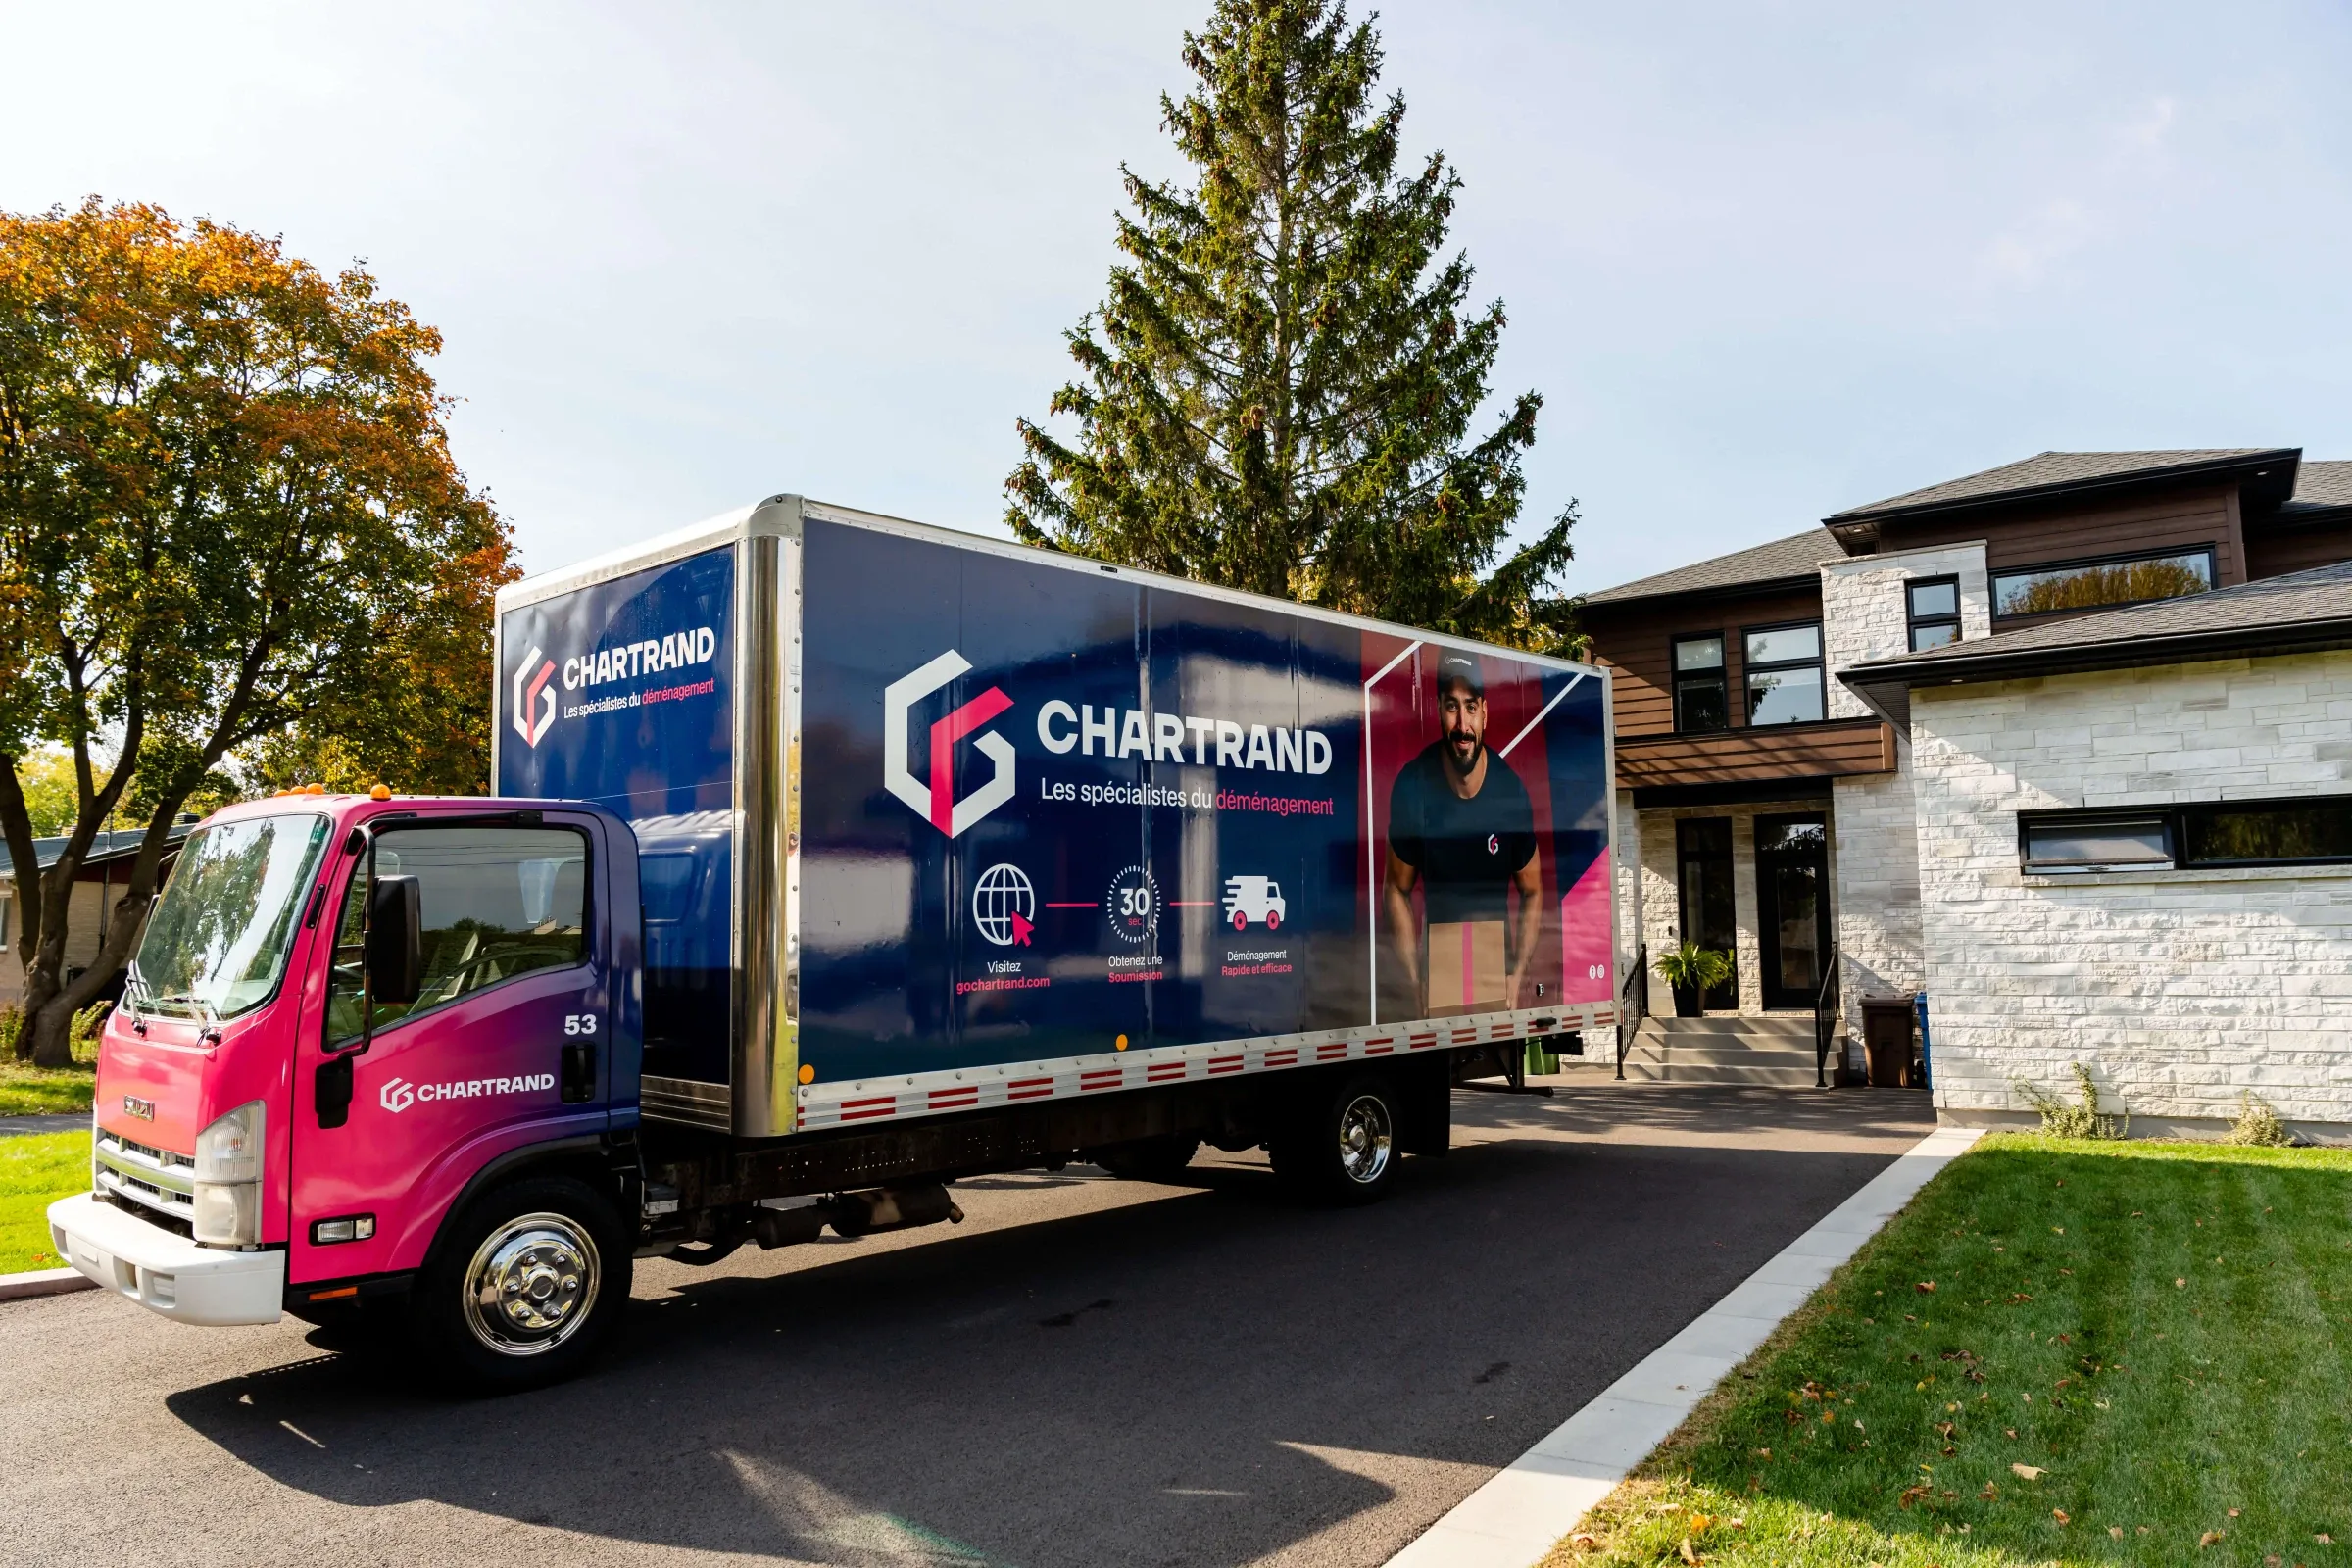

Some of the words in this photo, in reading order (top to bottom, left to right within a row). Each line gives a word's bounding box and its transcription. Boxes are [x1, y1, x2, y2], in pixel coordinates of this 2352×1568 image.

[564, 627, 715, 691] CHARTRAND
[564, 706, 578, 719] Les
[579, 697, 628, 719] spécialistes
[628, 691, 641, 707] du
[642, 678, 714, 705] déménagement
[1037, 700, 1332, 774] CHARTRAND
[1041, 777, 1076, 801] Les
[1080, 781, 1187, 808] spécialistes
[1191, 787, 1212, 808] du
[1215, 788, 1334, 817] déménagement
[1120, 887, 1150, 916] 30
[987, 960, 1022, 974] Visitez
[1108, 956, 1146, 967] Obtenez
[1147, 956, 1163, 965] une
[1227, 949, 1287, 962] Déménagement
[1108, 968, 1163, 983] Soumission
[1221, 964, 1250, 977] Rapide
[1251, 964, 1260, 974] et
[1261, 962, 1293, 974] efficace
[956, 975, 1051, 994] gochartrand.com
[564, 1013, 597, 1036] 53
[417, 1073, 555, 1102] CHARTRAND
